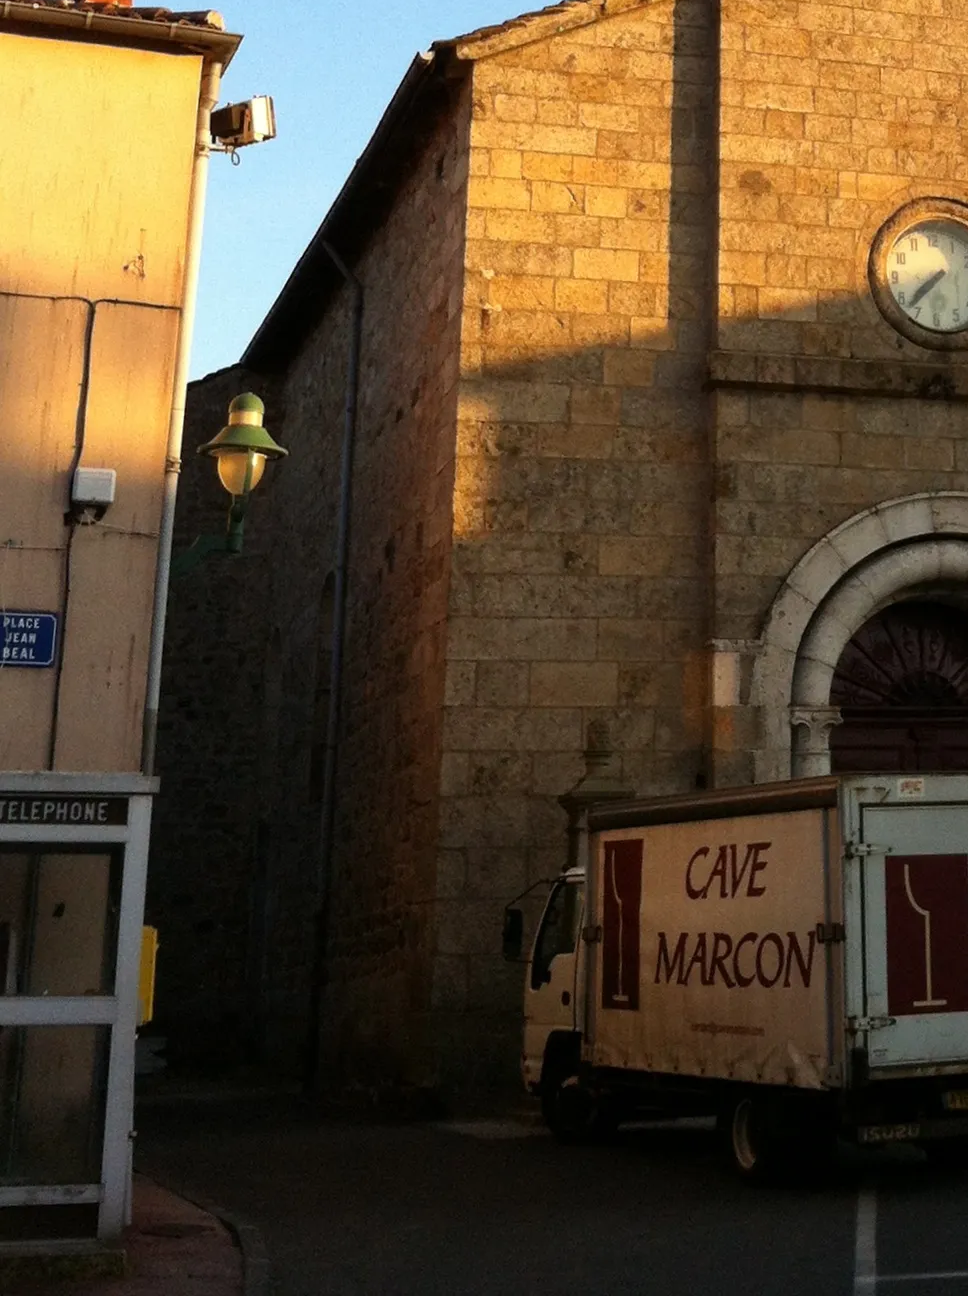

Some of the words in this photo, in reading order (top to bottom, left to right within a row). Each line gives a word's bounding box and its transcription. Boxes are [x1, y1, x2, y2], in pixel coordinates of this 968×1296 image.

[910, 238, 918, 251] 11
[927, 235, 939, 248] 12
[896, 252, 905, 264] 10
[891, 271, 899, 285] 9
[897, 291, 905, 305] 8
[914, 307, 921, 320] 7
[932, 313, 940, 327] 6
[952, 308, 960, 323] 5
[3, 617, 41, 629] PLACE
[4, 632, 37, 644] JEAN
[2, 647, 36, 660] BEAL
[685, 842, 772, 900] CAVE
[654, 930, 817, 989] MARCON
[861, 1123, 921, 1142] ISUZU
